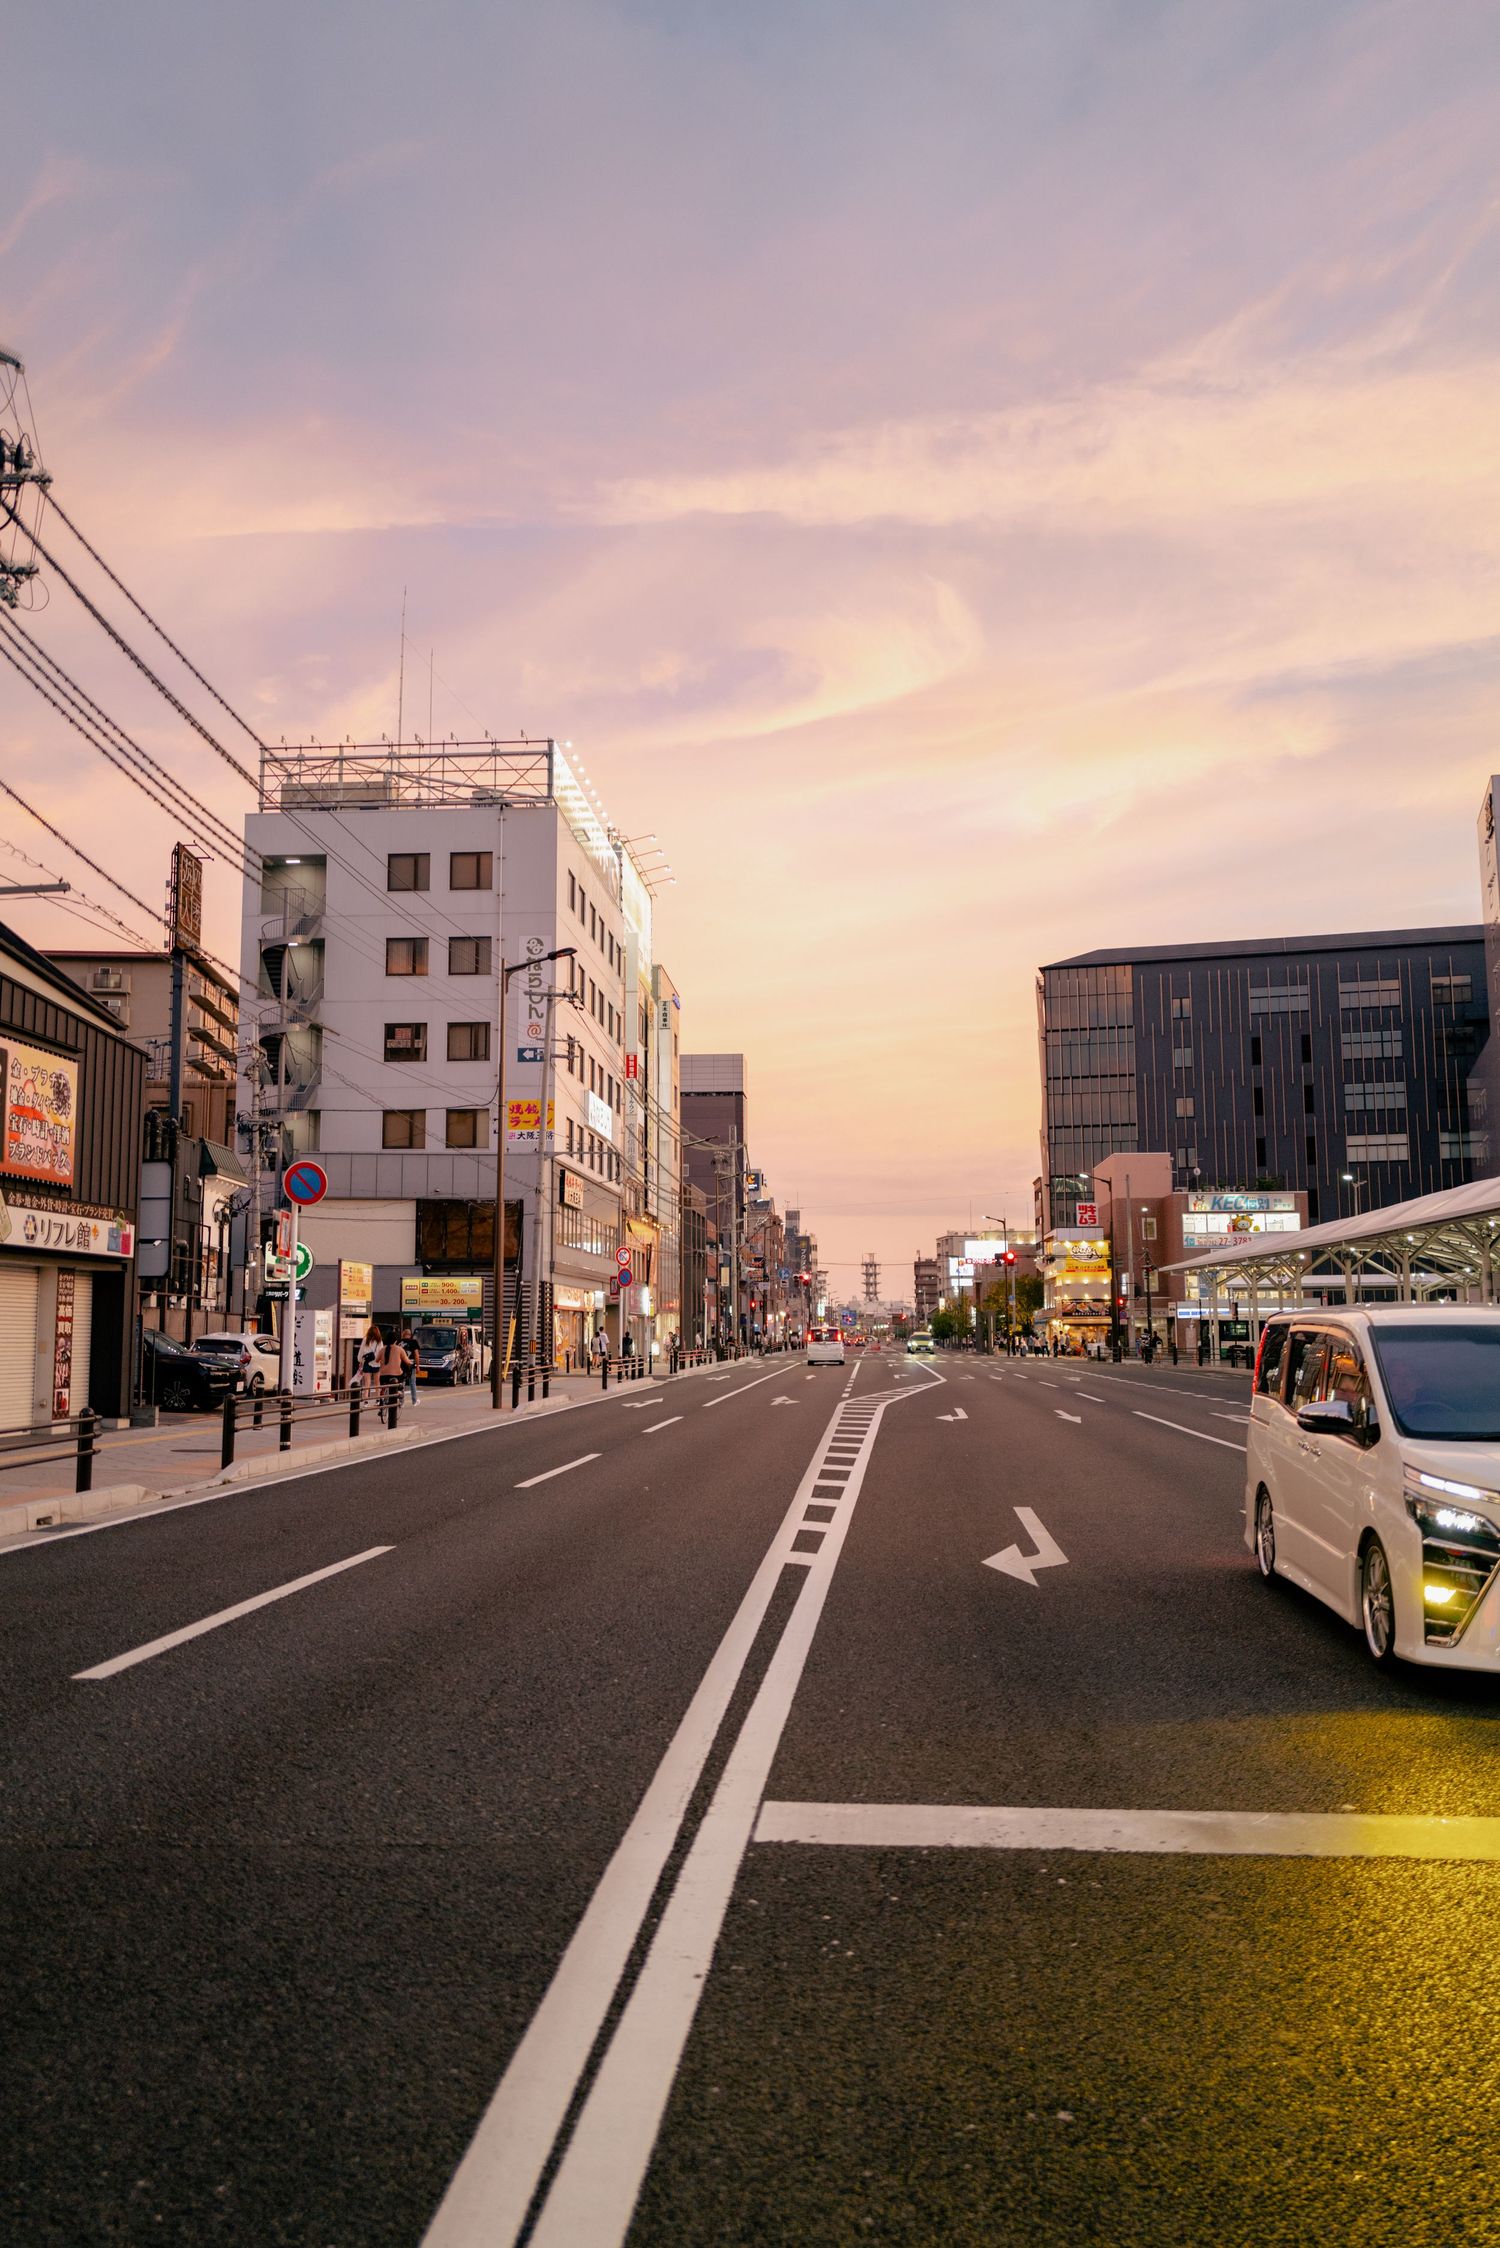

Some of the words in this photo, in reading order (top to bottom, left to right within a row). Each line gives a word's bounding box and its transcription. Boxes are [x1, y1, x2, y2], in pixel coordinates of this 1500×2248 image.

[526, 956, 544, 1020] ならしん
[8, 1141, 69, 1169] ブランドバッグ
[1077, 1204, 1097, 1215] ツキ
[1078, 1215, 1097, 1225] ムラ
[40, 1218, 92, 1251] リフレ館
[57, 1321, 72, 1335] 買取
